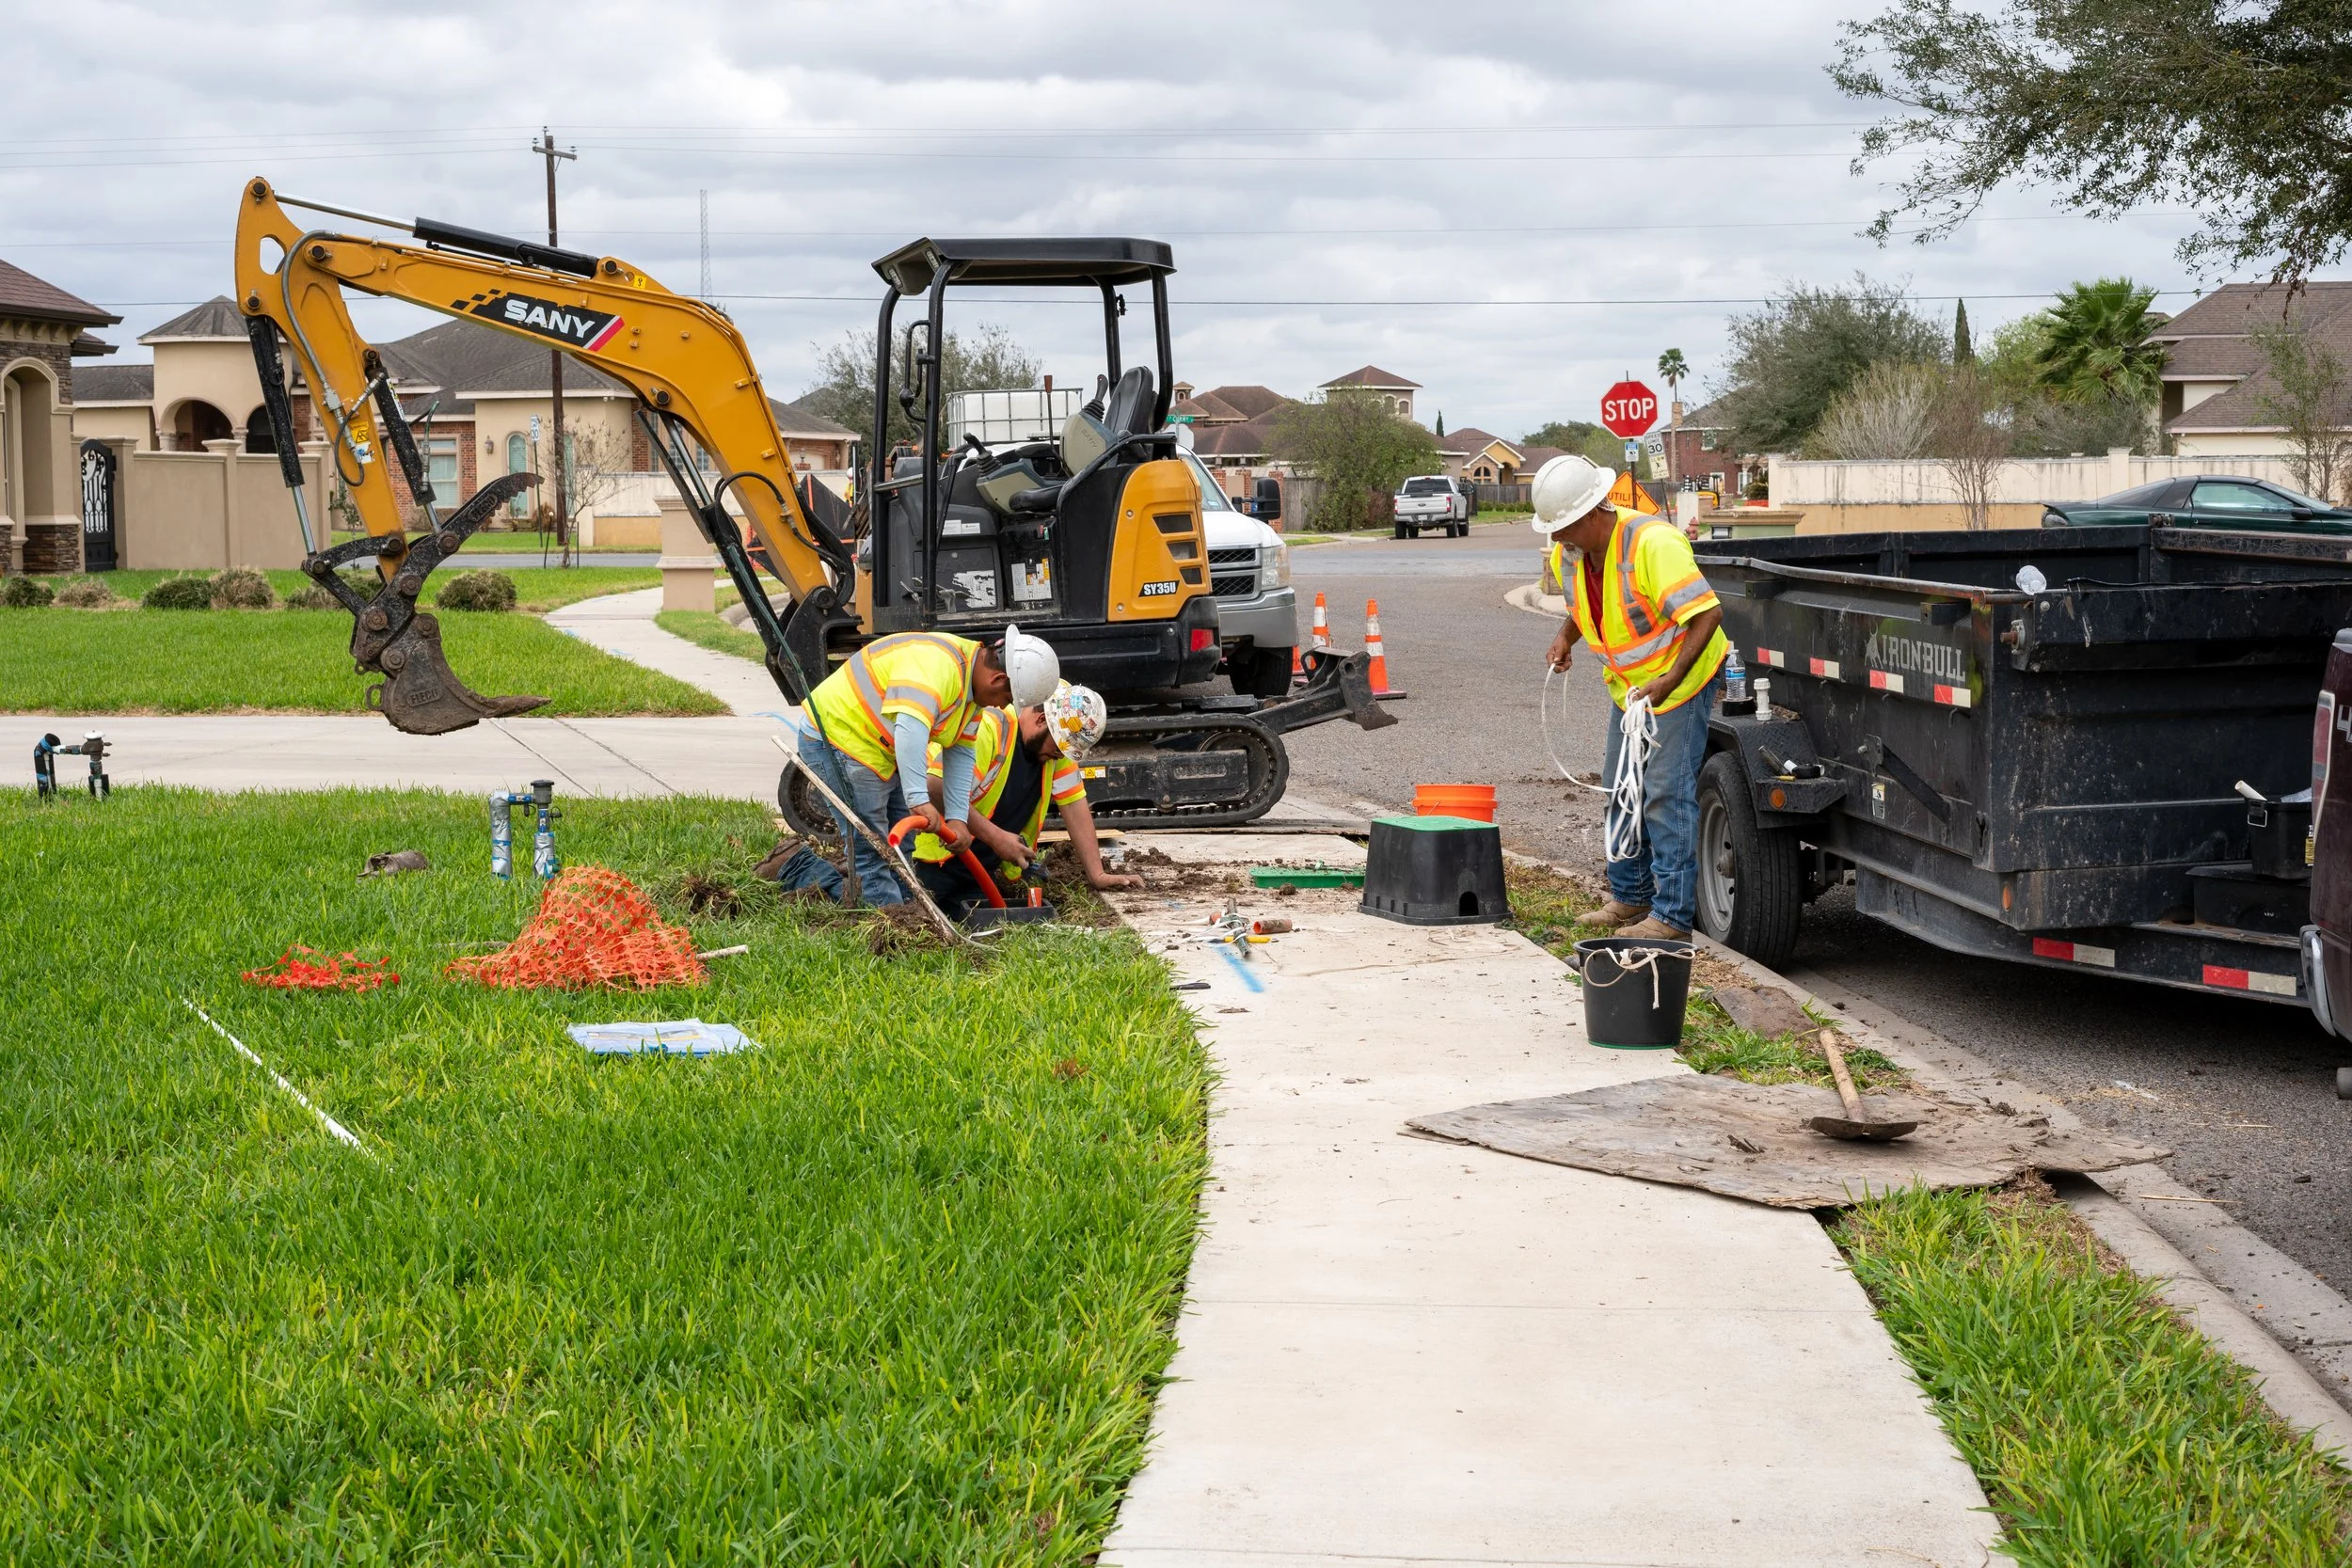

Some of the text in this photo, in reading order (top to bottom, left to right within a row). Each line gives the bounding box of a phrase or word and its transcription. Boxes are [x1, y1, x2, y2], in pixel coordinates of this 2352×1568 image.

[504, 299, 596, 339] SANY
[1605, 397, 1654, 421] STOP
[1648, 443, 1662, 453] 30
[1608, 492, 1643, 501] UTILIY
[1143, 581, 1176, 595] SY35U
[1883, 634, 1965, 681] IRONBULL
